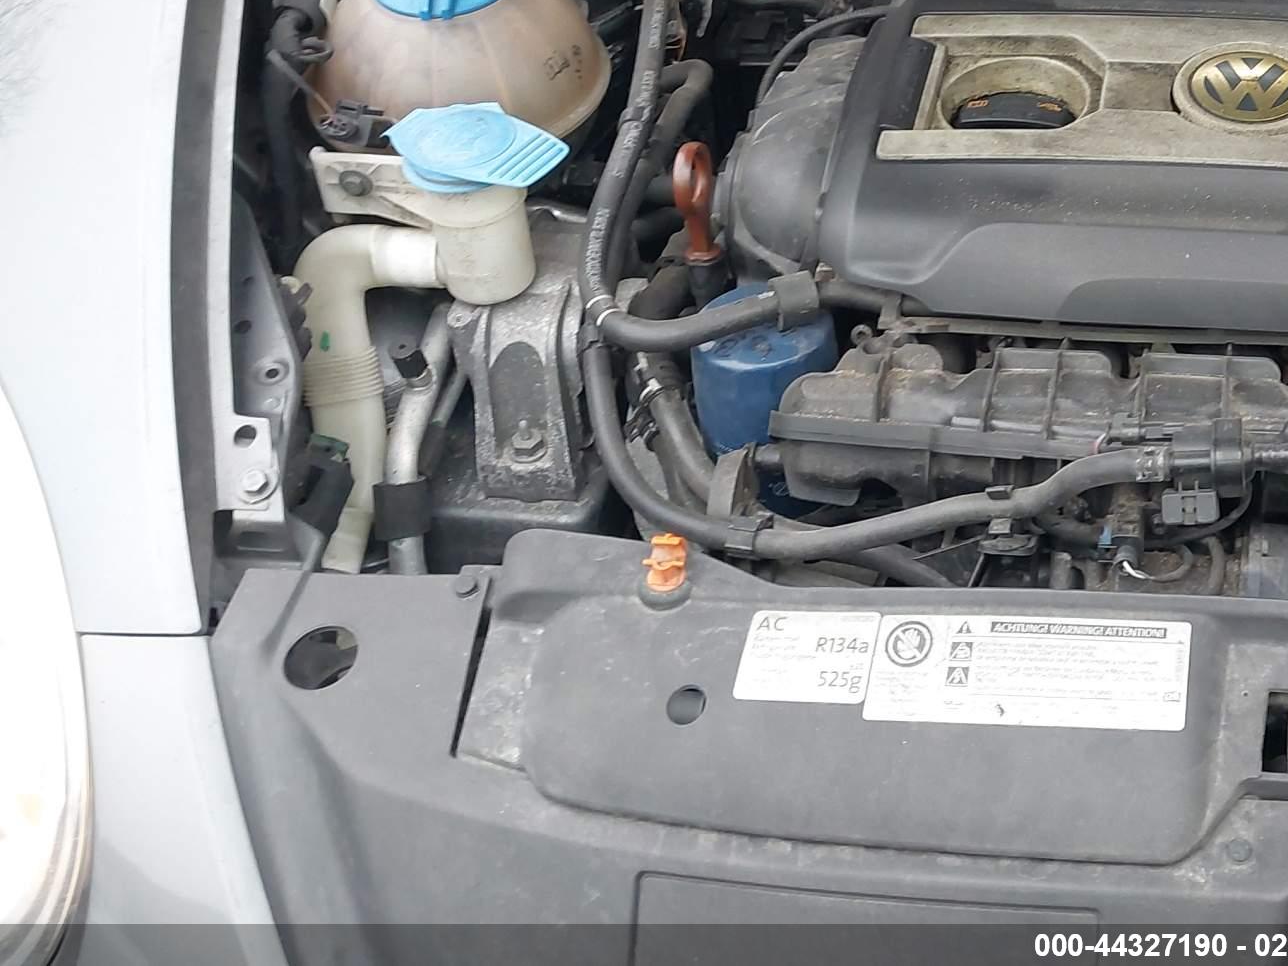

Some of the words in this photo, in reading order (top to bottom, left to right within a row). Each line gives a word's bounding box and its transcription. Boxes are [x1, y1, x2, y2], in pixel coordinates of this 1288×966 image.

[757, 616, 788, 632] AC
[994, 622, 1050, 634] ACHTUNG!
[1050, 623, 1104, 636] WARNING!
[1104, 625, 1165, 639] ATTENTION!
[815, 637, 870, 653] R134a
[817, 670, 863, 694] 525g
